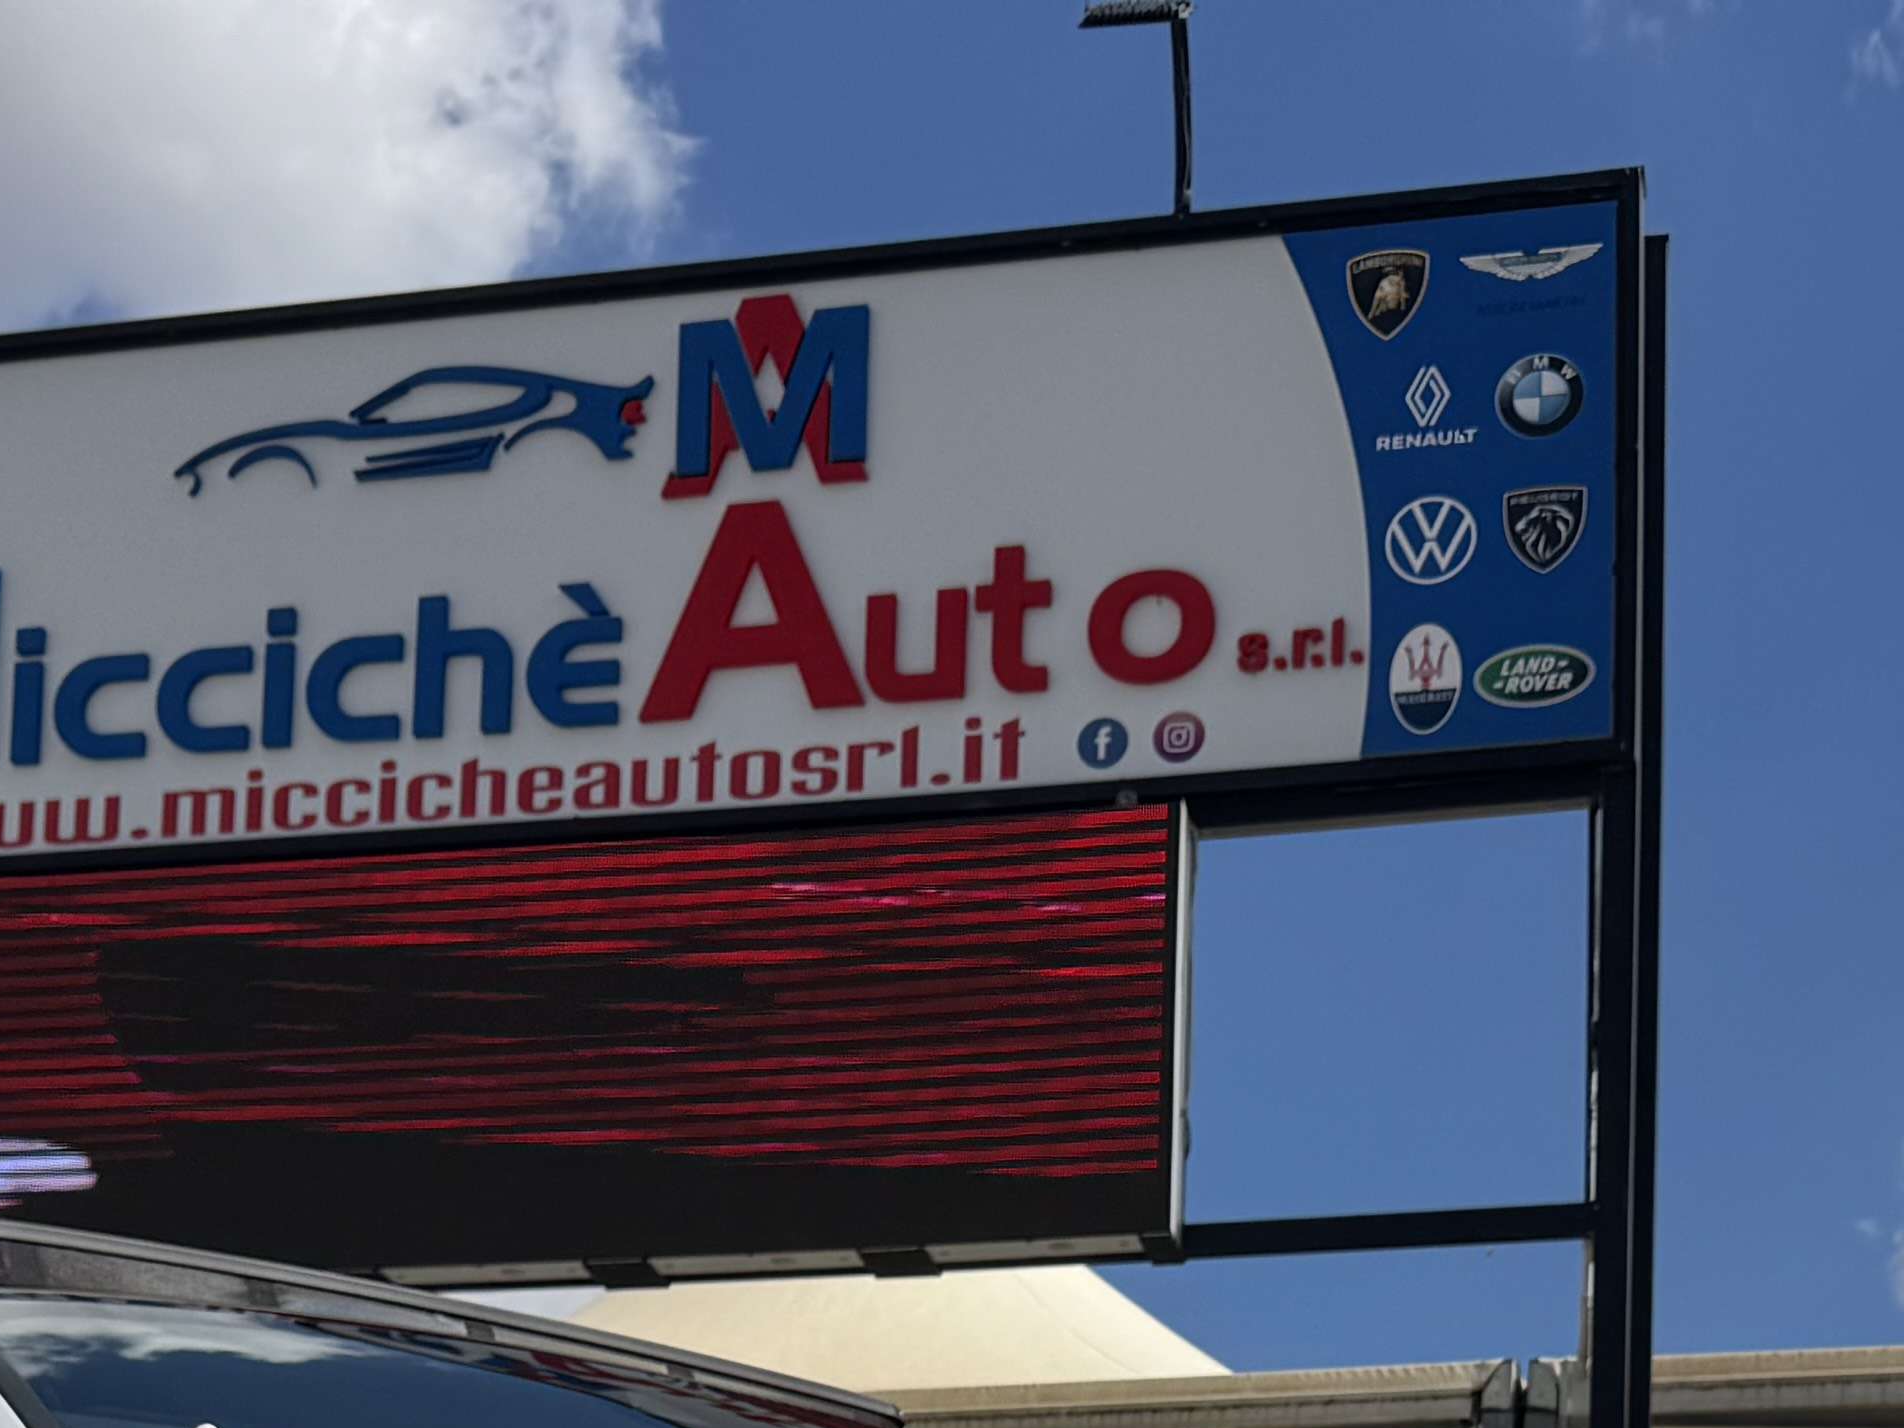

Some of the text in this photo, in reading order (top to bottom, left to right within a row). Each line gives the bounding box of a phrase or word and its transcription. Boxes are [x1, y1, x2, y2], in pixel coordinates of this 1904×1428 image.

[1375, 427, 1479, 451] RENAULT
[638, 500, 1216, 723] Auto
[1237, 616, 1366, 675] s.r.l.
